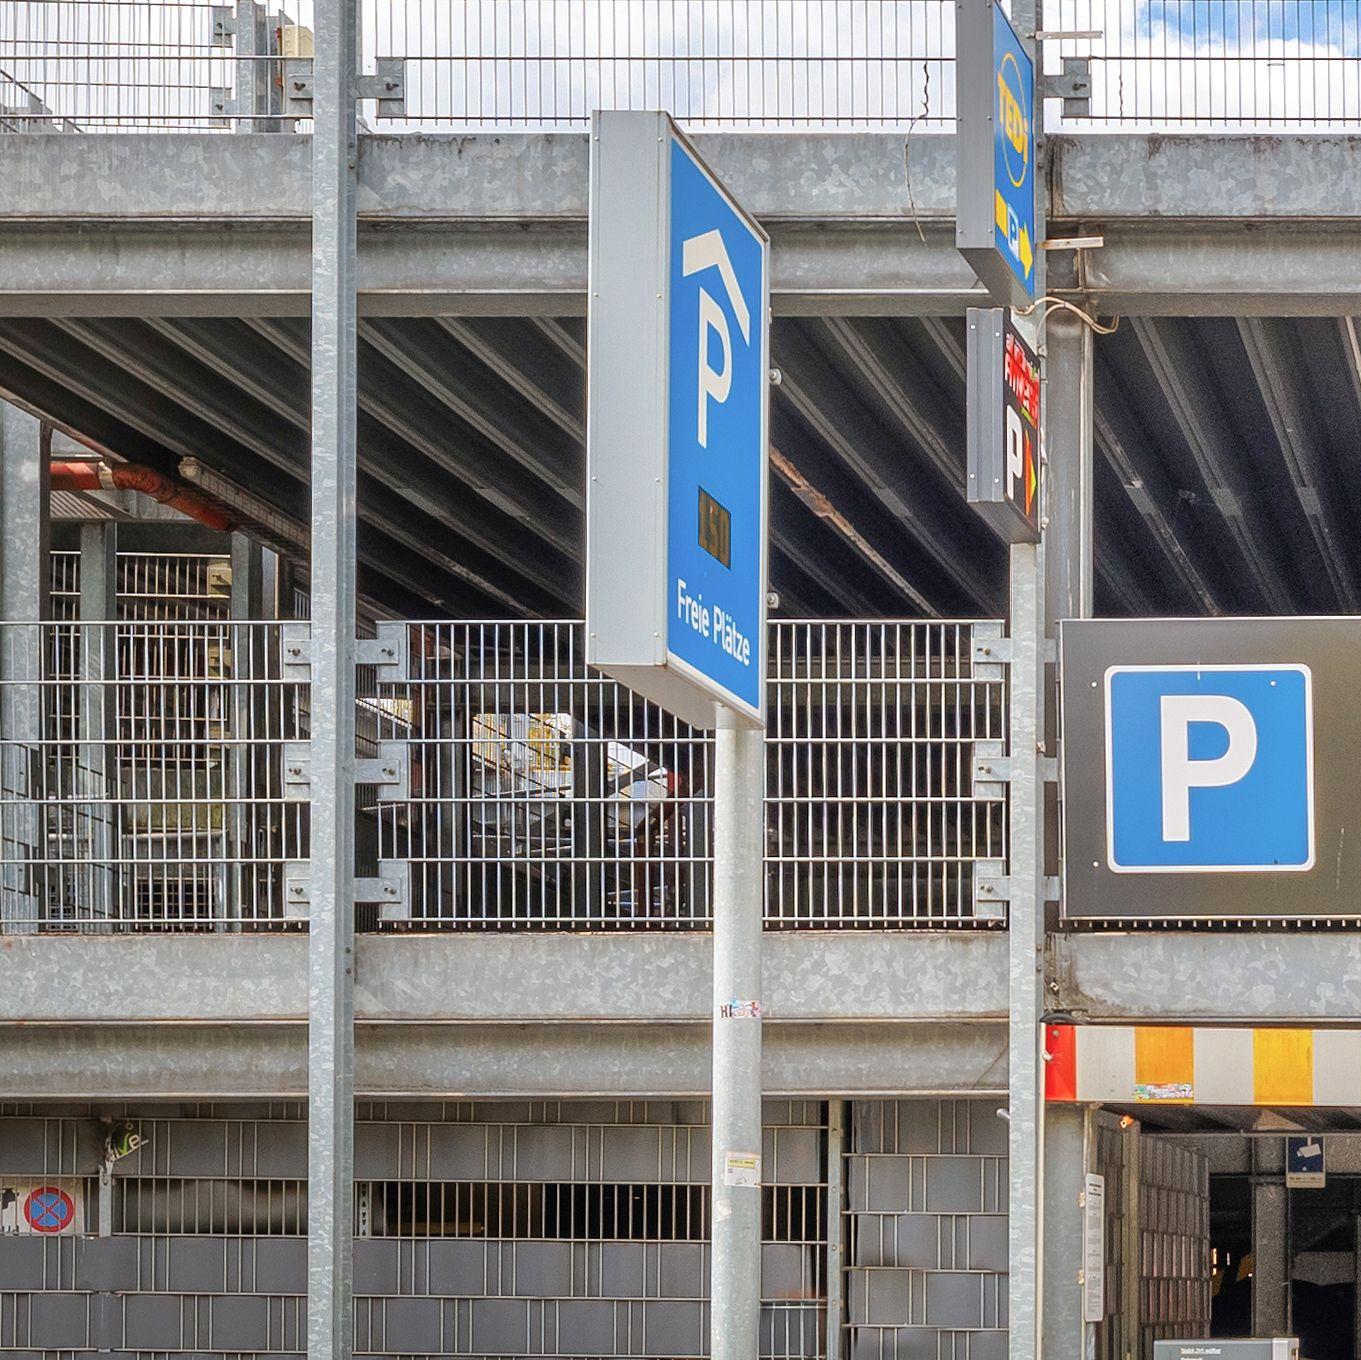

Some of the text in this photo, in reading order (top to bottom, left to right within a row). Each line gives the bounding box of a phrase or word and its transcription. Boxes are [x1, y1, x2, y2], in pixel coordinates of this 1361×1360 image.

[997, 72, 1028, 165] TEDi
[698, 286, 732, 448] P
[1006, 404, 1023, 500] P
[677, 577, 750, 666] Freie Plätze
[1160, 695, 1257, 842] P
